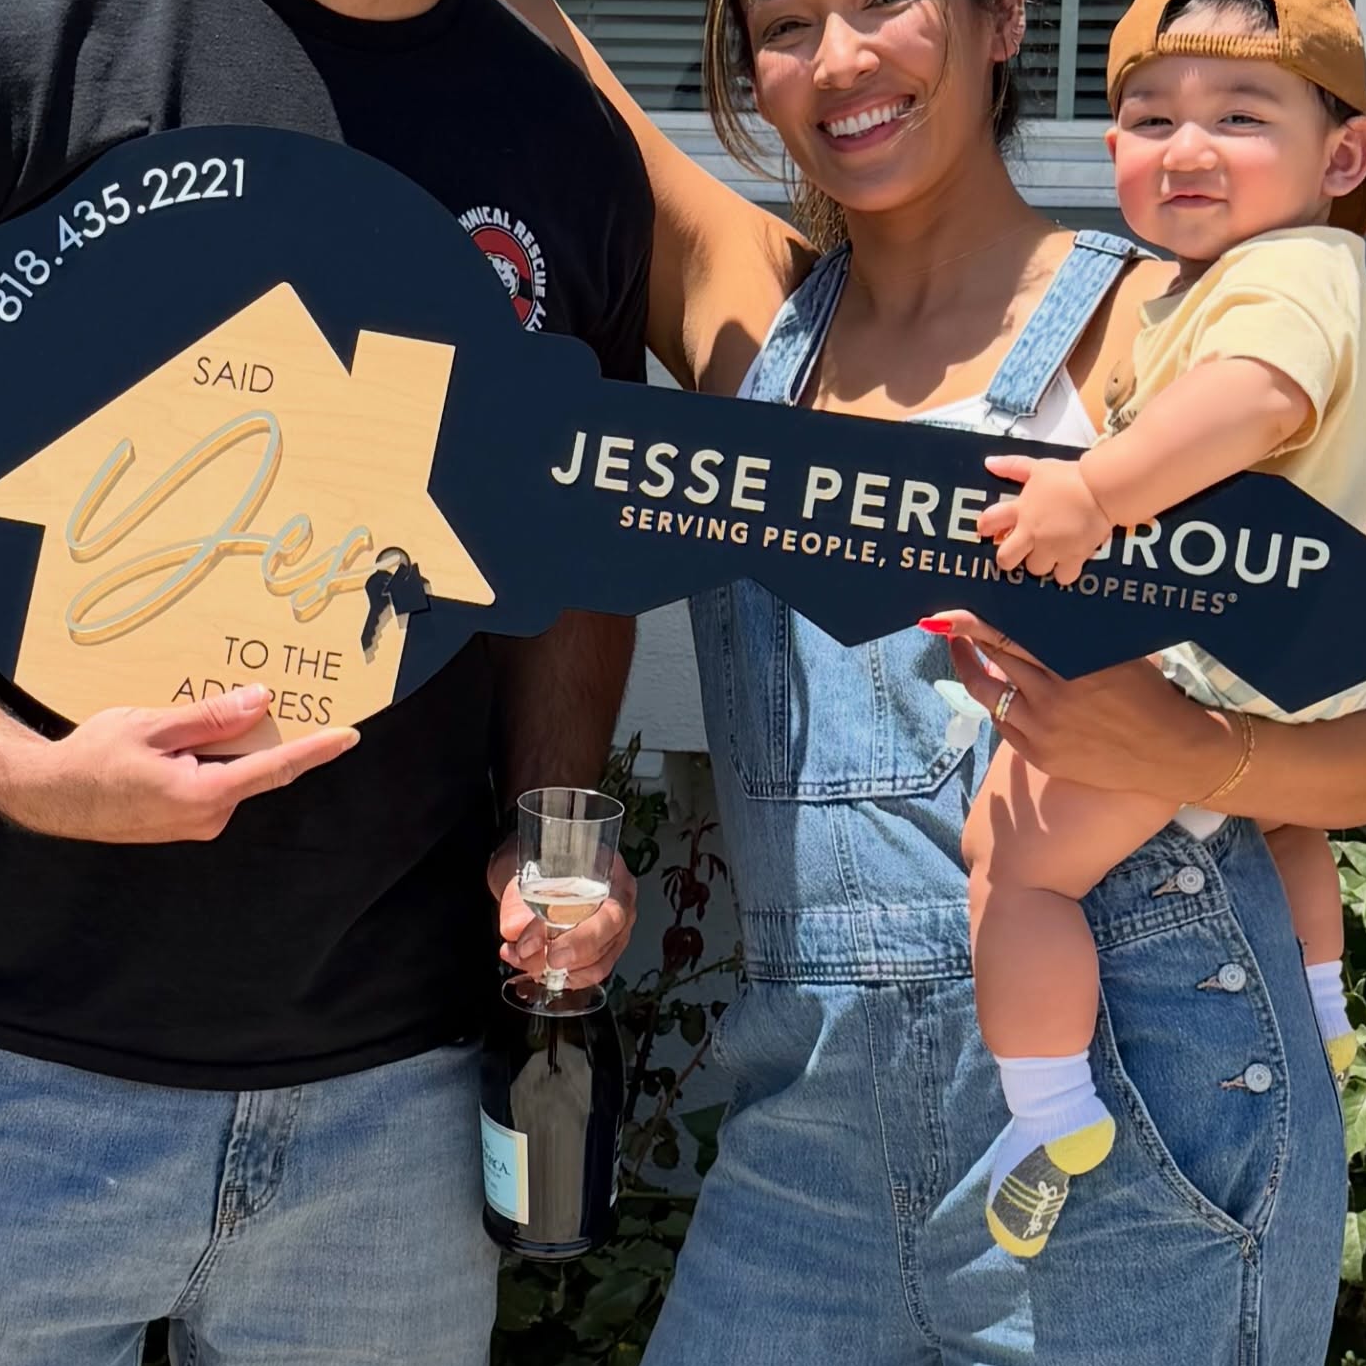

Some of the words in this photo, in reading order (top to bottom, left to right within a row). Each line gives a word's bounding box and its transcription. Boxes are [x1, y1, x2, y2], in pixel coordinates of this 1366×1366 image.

[513, 220, 547, 298] RESCUE
[192, 355, 275, 394] SAID
[65, 409, 399, 646] Yes
[550, 430, 772, 513] JESSE
[801, 465, 1021, 546] PERE
[1089, 516, 1332, 589] ROUP
[619, 505, 750, 546] SERVING
[762, 525, 887, 569] PEOPLE,
[899, 546, 1025, 585] SELLING
[224, 635, 270, 670] TO
[282, 644, 344, 682] THE
[170, 676, 334, 726] ADESS
